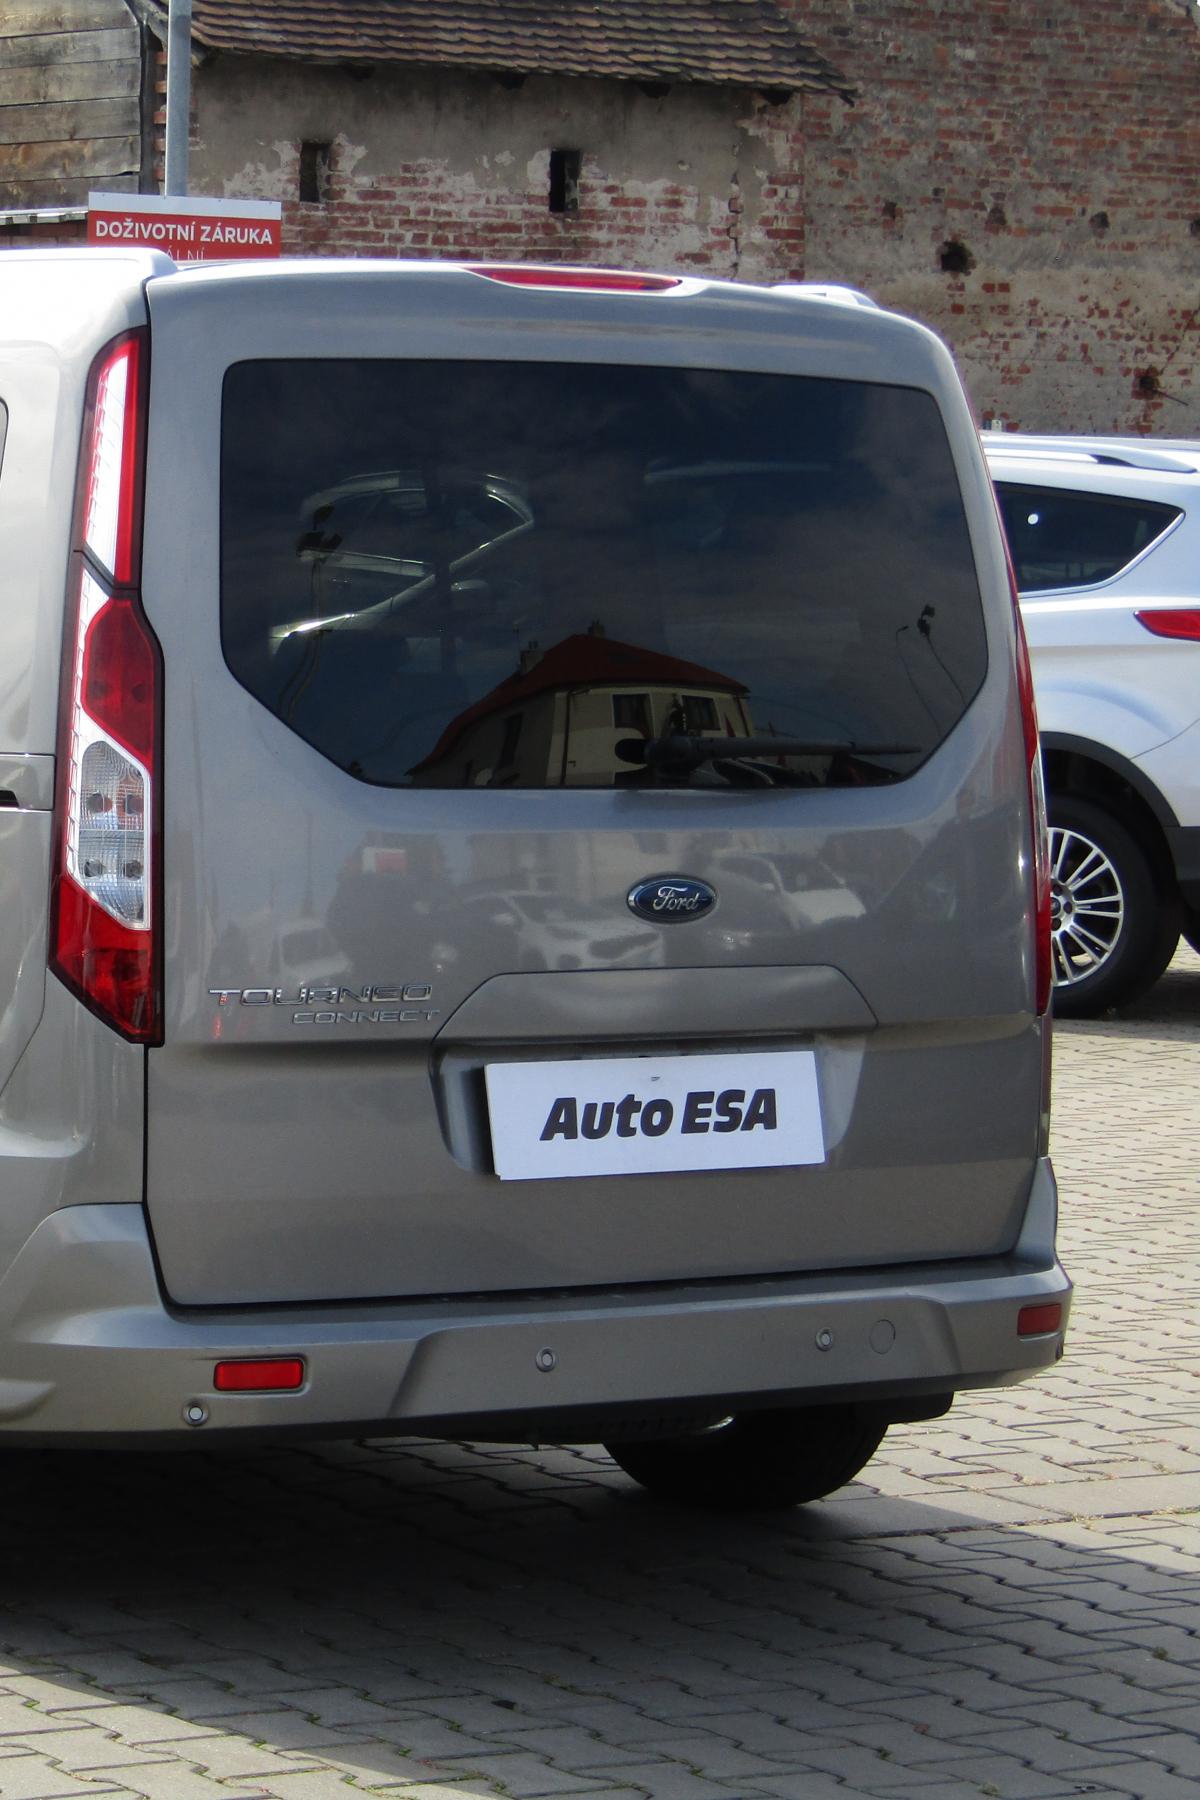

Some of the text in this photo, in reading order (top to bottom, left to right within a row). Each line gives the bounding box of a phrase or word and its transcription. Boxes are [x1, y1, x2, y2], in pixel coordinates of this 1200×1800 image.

[95, 218, 273, 244] DOŽIVOTNÍ ZÁRUKA
[652, 885, 701, 911] Ford
[208, 984, 433, 1006] TOURNEO
[292, 1009, 440, 1025] CONNECT
[539, 1088, 778, 1142] Auto ESA
